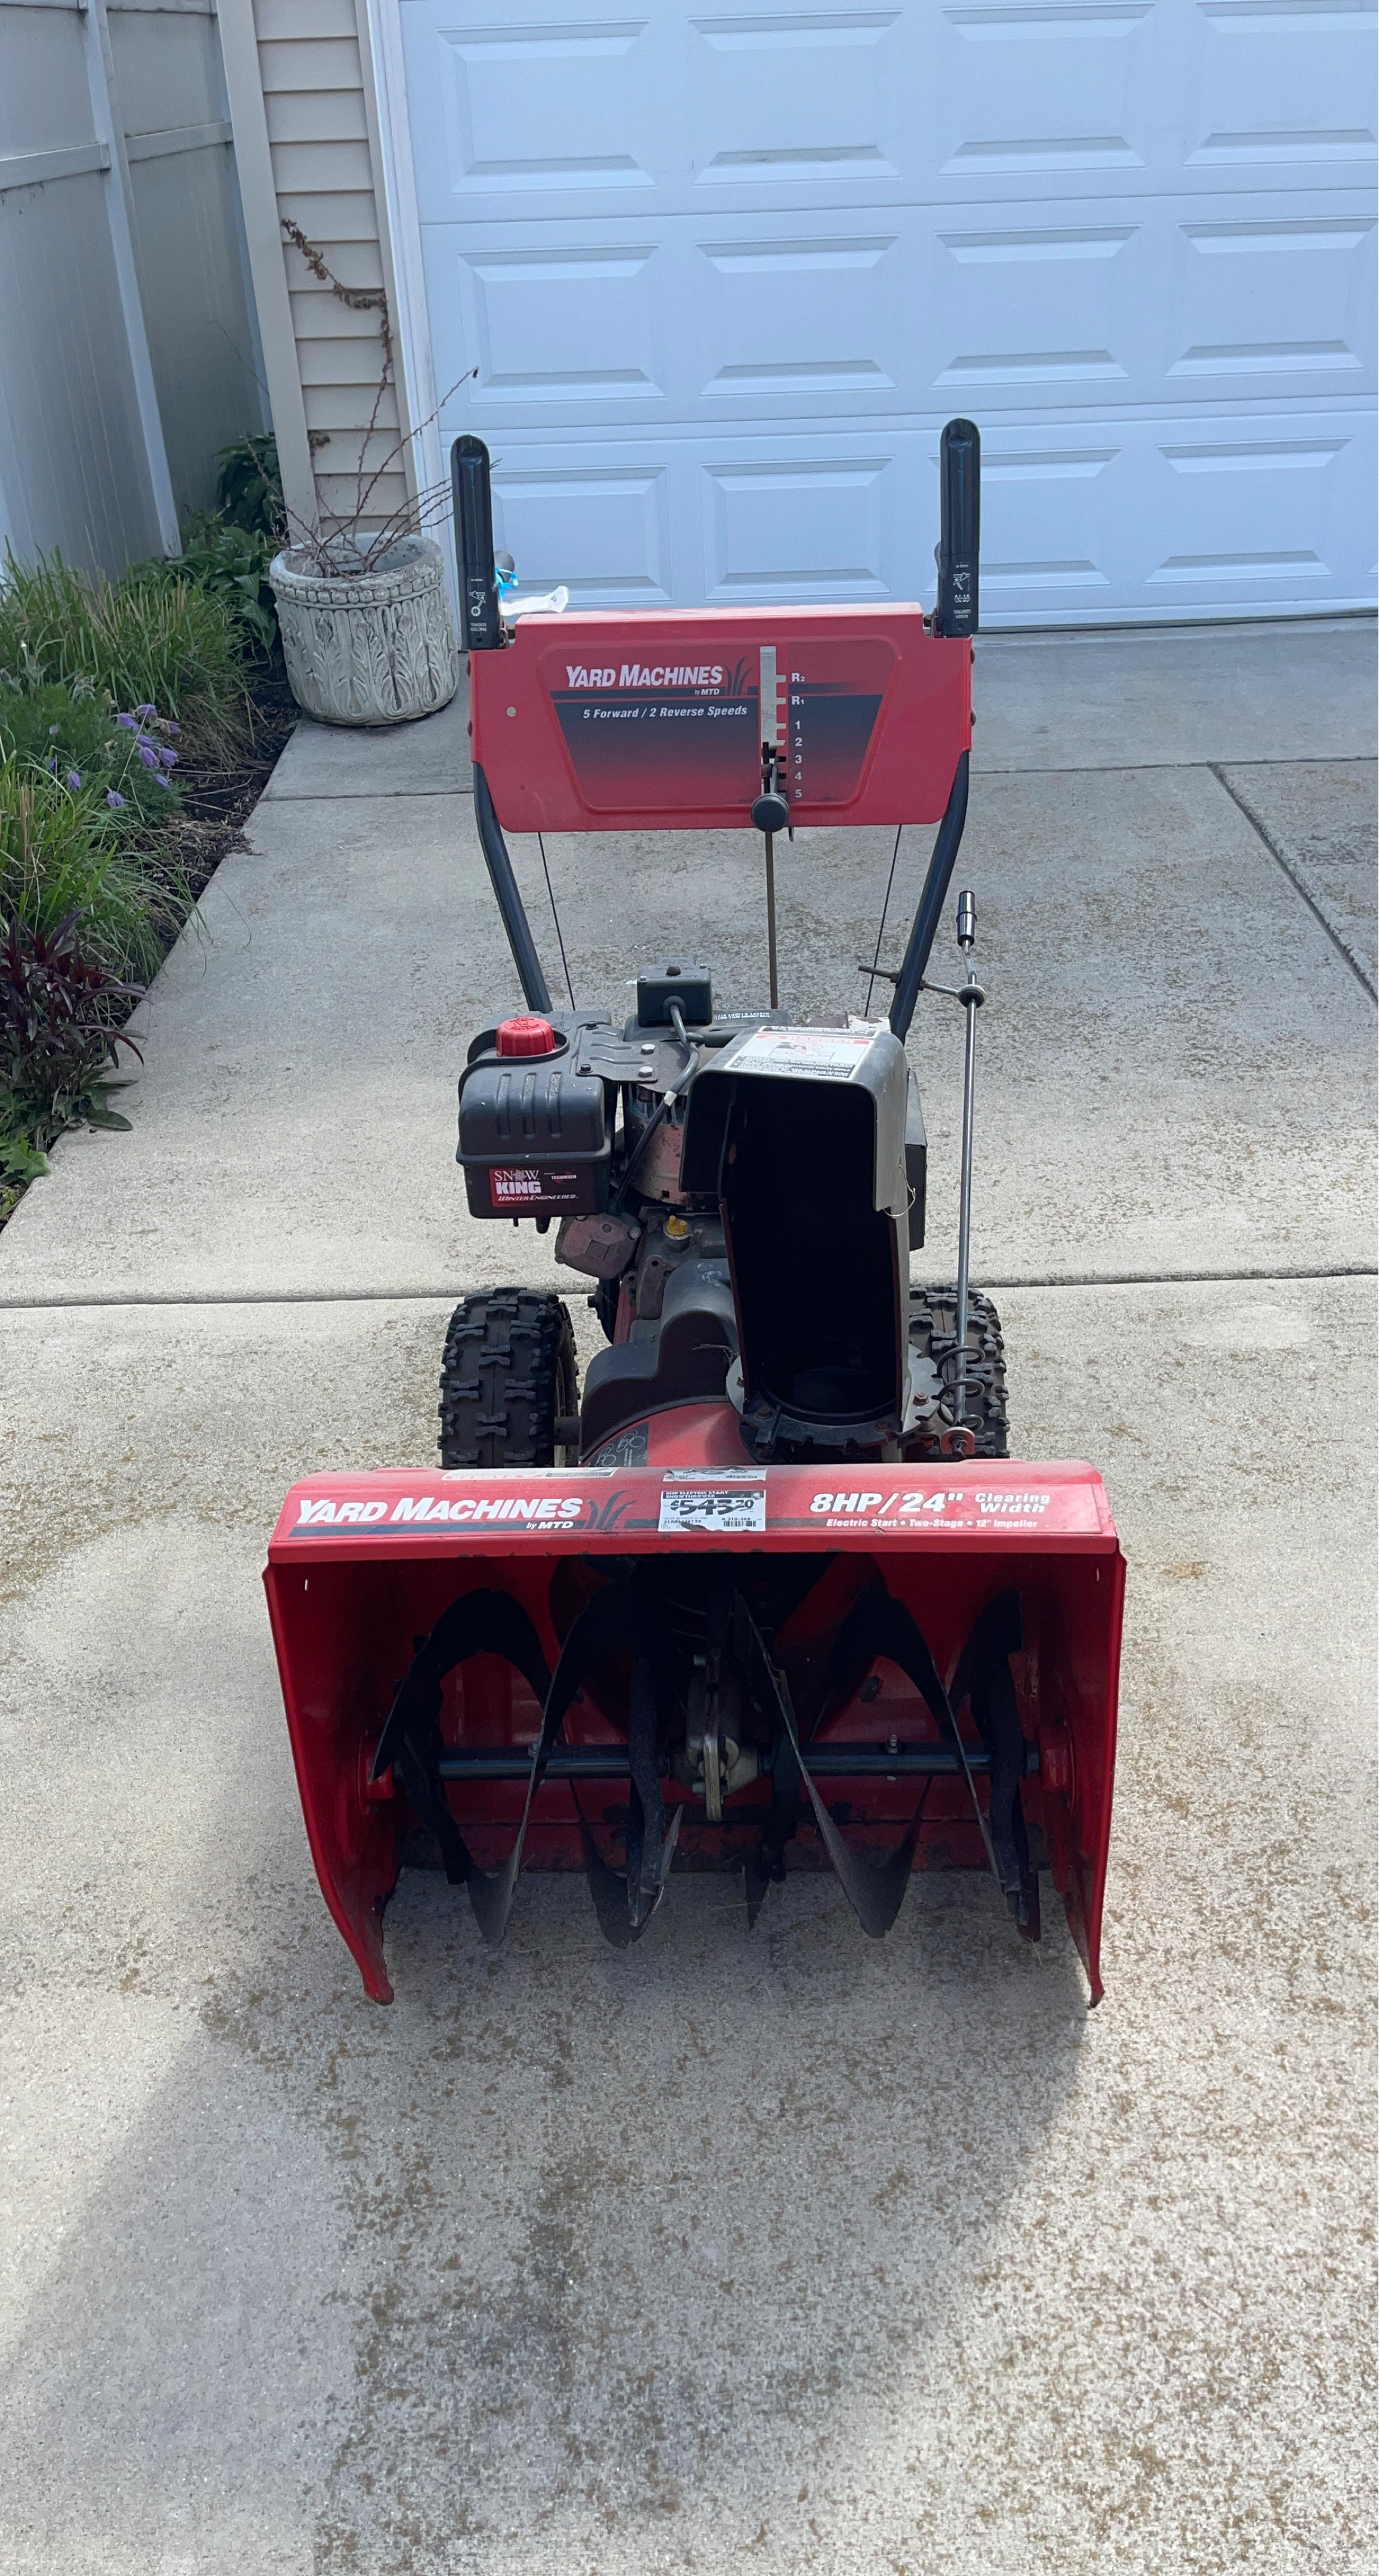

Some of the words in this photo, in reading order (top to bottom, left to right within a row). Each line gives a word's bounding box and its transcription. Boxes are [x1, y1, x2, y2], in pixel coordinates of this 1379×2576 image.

[566, 665, 615, 687] YARD
[619, 664, 723, 686] MACHINES
[583, 709, 590, 719] 5
[593, 708, 639, 719] Forward
[649, 707, 657, 717] 2
[660, 707, 704, 717] Reverse
[707, 705, 748, 717] Speeds
[795, 720, 800, 729] 1
[795, 737, 802, 747] 2
[795, 755, 802, 764] 3
[795, 771, 802, 780] 4
[795, 789, 802, 798] 5
[495, 1181, 541, 1194] KING
[975, 1493, 1050, 1504] Clearing
[296, 1499, 388, 1524] YARD
[389, 1497, 583, 1521] MACHINES
[980, 1503, 1045, 1513] Width
[826, 1519, 867, 1527] Electric
[870, 1519, 897, 1527] Start
[909, 1519, 963, 1528] Two-Stage
[993, 1519, 1038, 1528] Impeller
